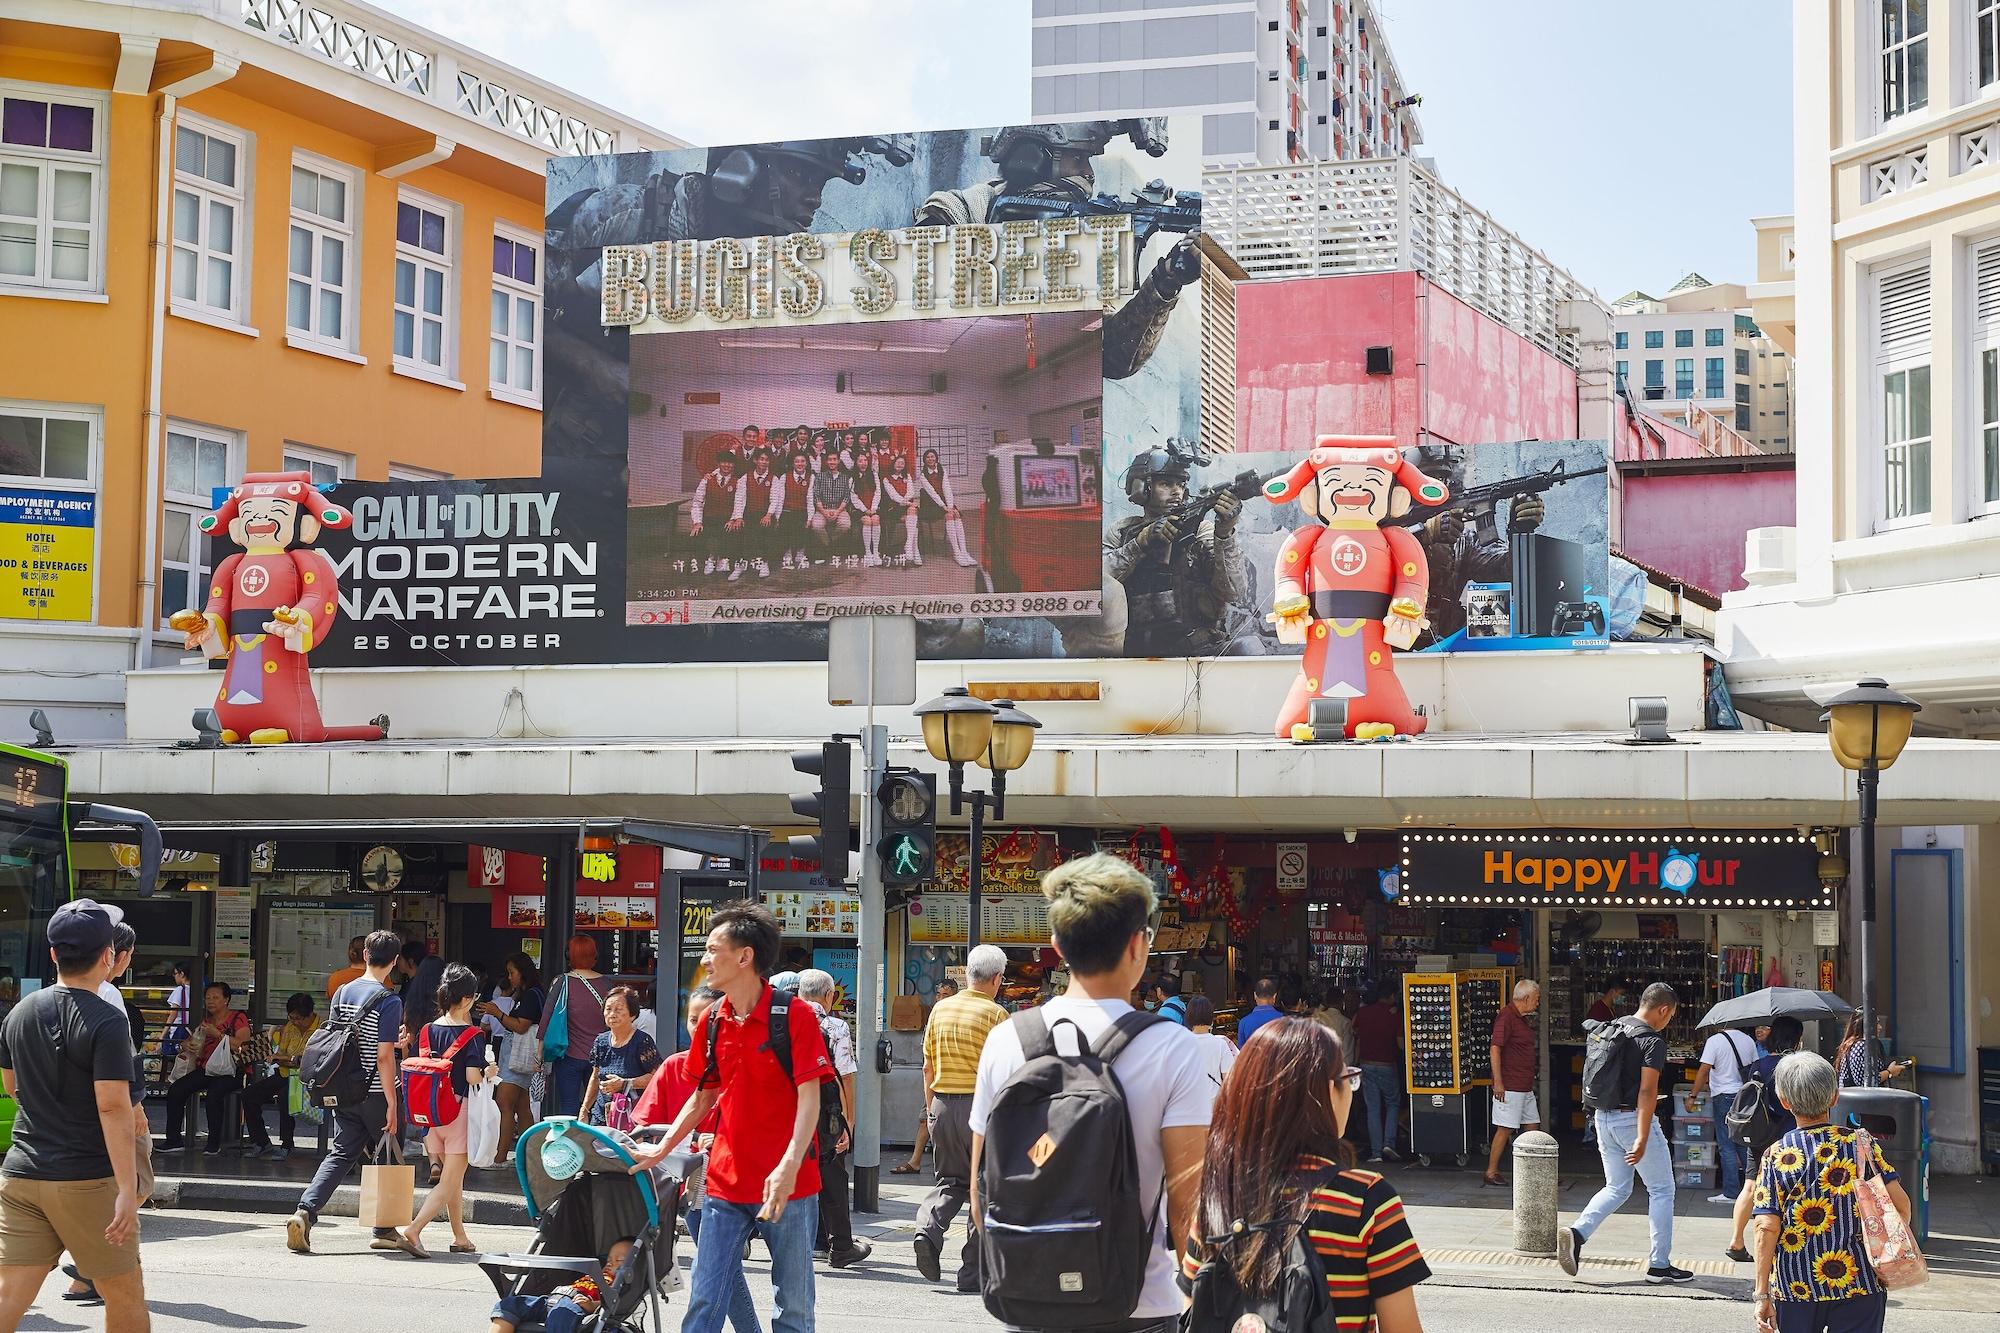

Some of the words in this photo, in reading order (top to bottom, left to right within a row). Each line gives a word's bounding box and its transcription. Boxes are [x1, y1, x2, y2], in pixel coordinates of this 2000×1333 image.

[601, 232, 825, 326] BUGIS
[849, 213, 1133, 314] STREET
[0, 496, 55, 508] MPLOYMENT
[57, 499, 92, 511] AGENCY
[352, 494, 444, 541] CALL
[439, 504, 455, 521] OF
[454, 492, 560, 539] DUTY
[26, 533, 56, 543] HOTEL
[0, 558, 17, 569] OD
[22, 560, 28, 569] &
[33, 560, 88, 572] BEVERAGES
[315, 542, 597, 580] MODERN
[22, 587, 55, 598] RETAIL
[637, 589, 676, 599] 3:34:20
[681, 588, 699, 597] PM
[711, 604, 808, 619] Advertising
[813, 602, 896, 618] Enquiries
[901, 601, 963, 615] Hotline
[970, 599, 1015, 613] 6333
[1022, 597, 1068, 612] 9888
[1073, 599, 1093, 611] or
[354, 635, 390, 650] 25
[410, 634, 561, 650] OCTOBER
[928, 882, 946, 892] Lau
[948, 882, 959, 892] Pa
[980, 882, 1015, 892] oasted
[1323, 930, 1337, 942] (Mix
[1481, 971, 1500, 979] Arriva
